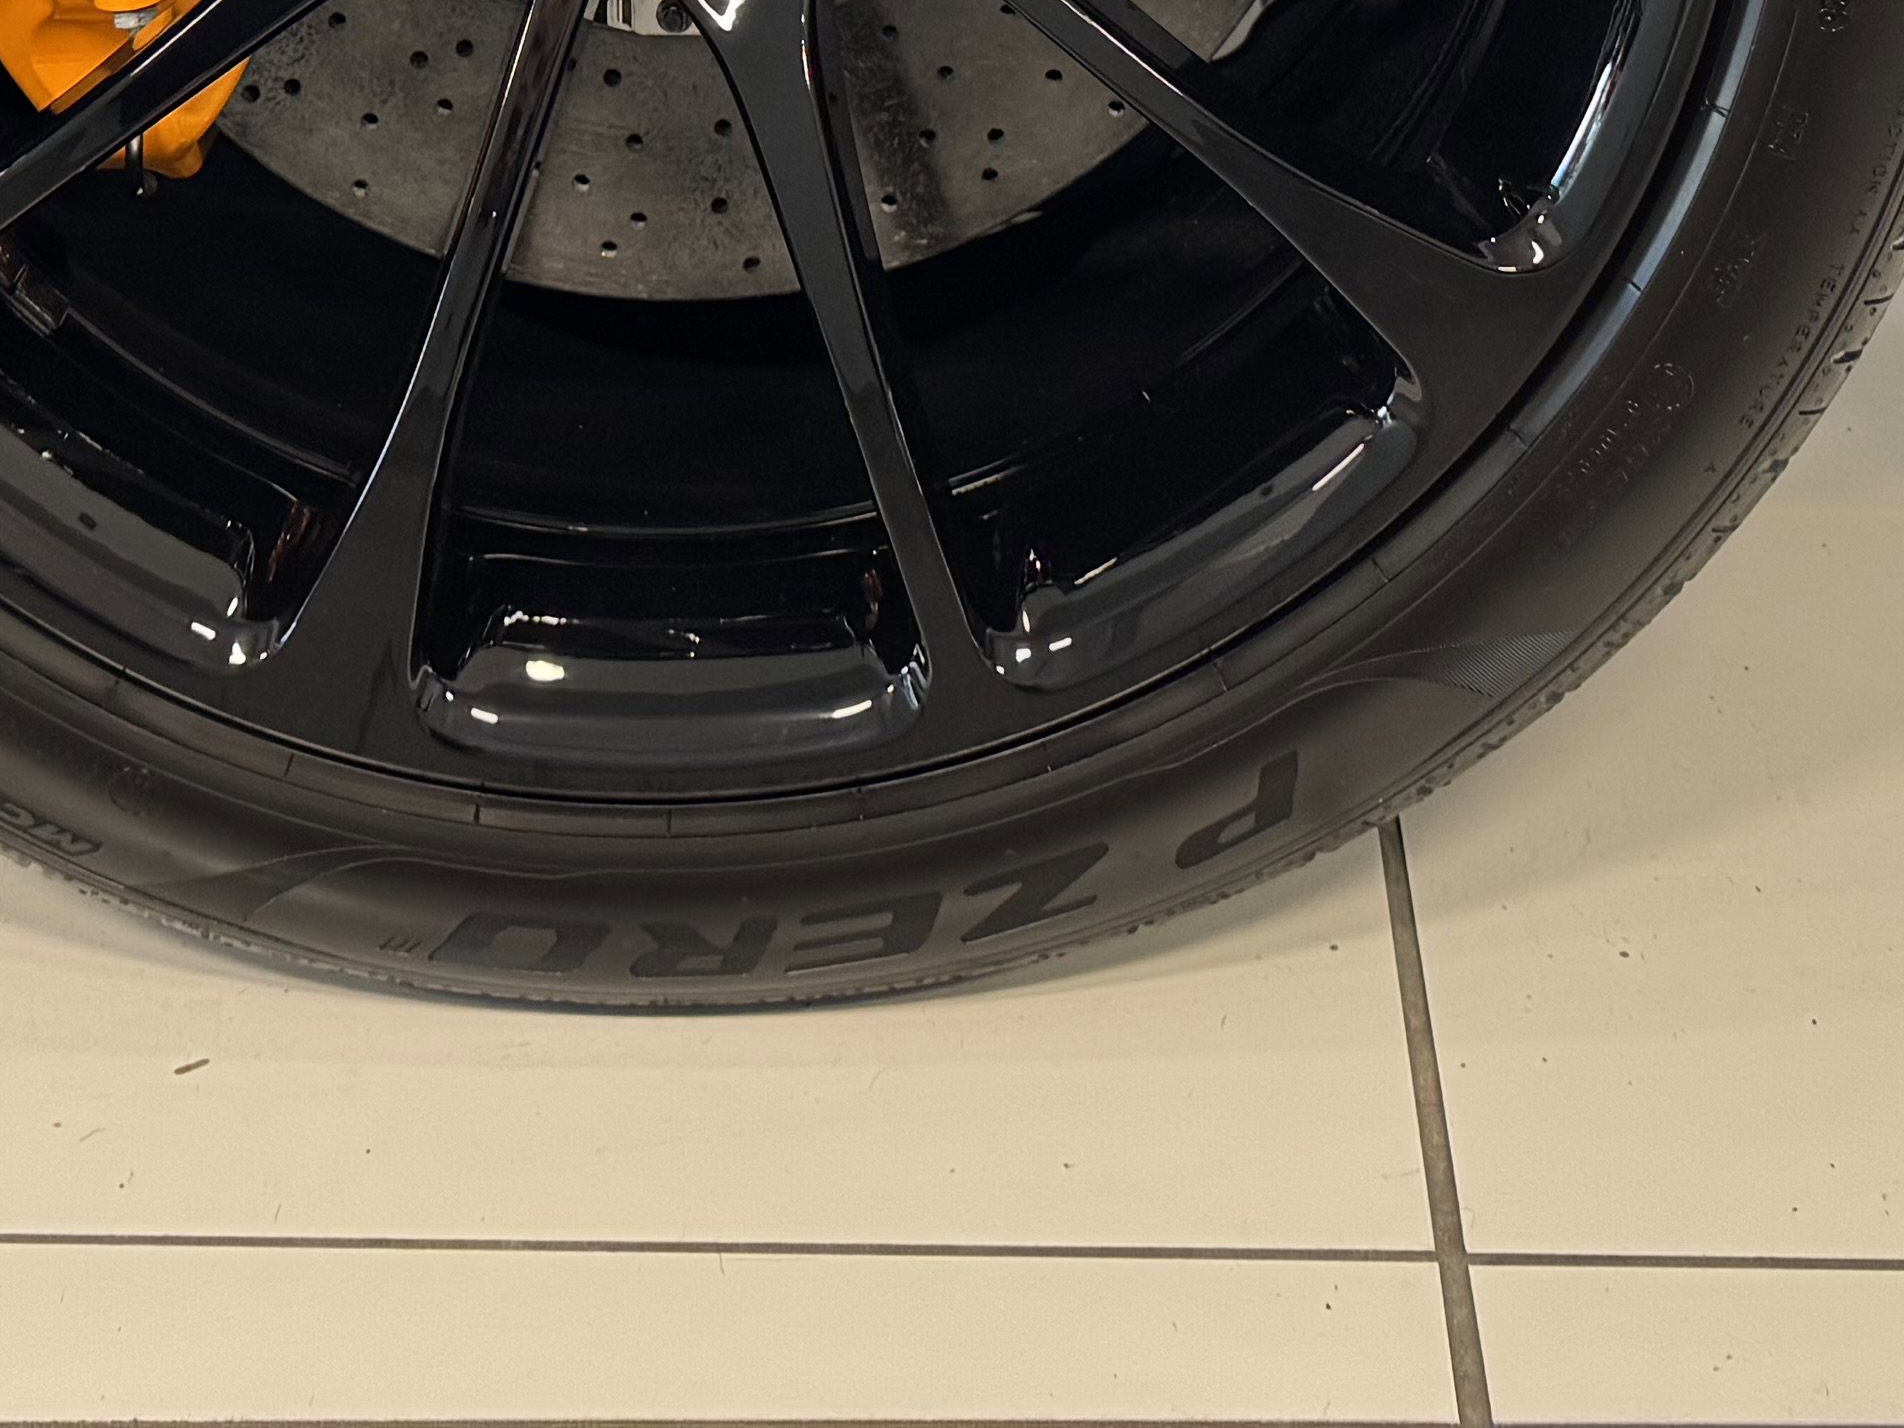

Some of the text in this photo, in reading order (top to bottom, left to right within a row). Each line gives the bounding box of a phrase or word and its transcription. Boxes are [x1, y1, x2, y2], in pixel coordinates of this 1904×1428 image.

[1736, 263, 1841, 428] TEMPERATURE
[429, 747, 1298, 979] P ZERO
